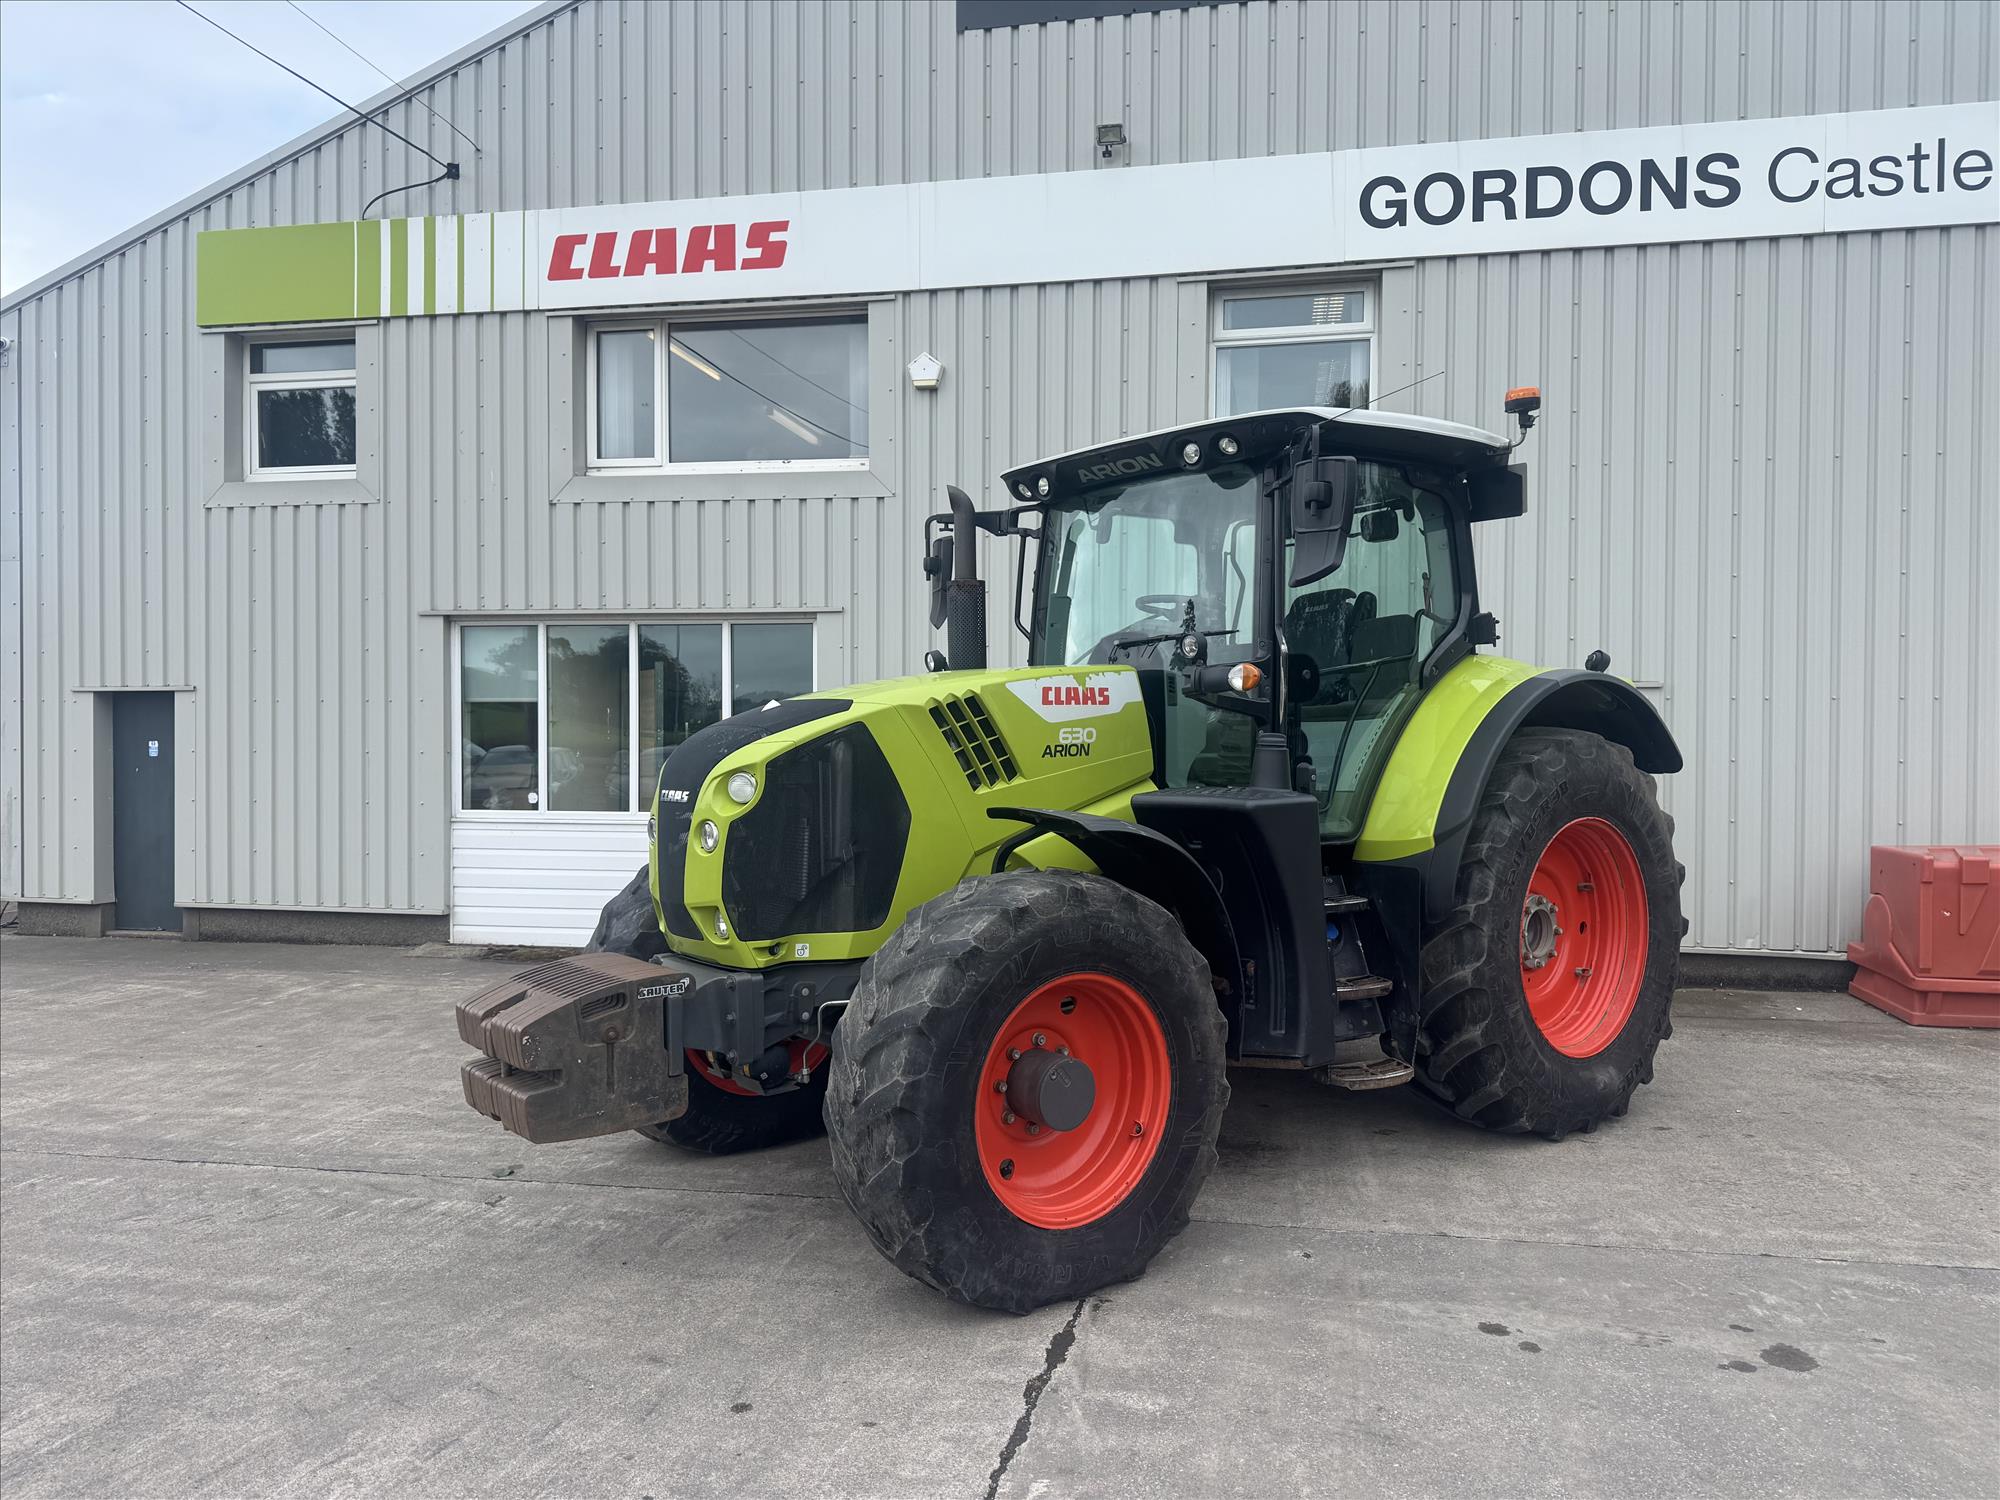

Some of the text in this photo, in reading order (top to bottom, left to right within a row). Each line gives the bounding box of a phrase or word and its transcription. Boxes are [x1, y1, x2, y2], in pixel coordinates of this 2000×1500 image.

[1358, 137, 1994, 229] GORDONS Castle
[547, 220, 790, 281] CLAAS
[1077, 452, 1164, 484] ARION
[1041, 686, 1110, 706] CLAAS
[1058, 727, 1097, 745] 630
[1041, 743, 1091, 759] ARION
[638, 982, 685, 999] SAUTER
